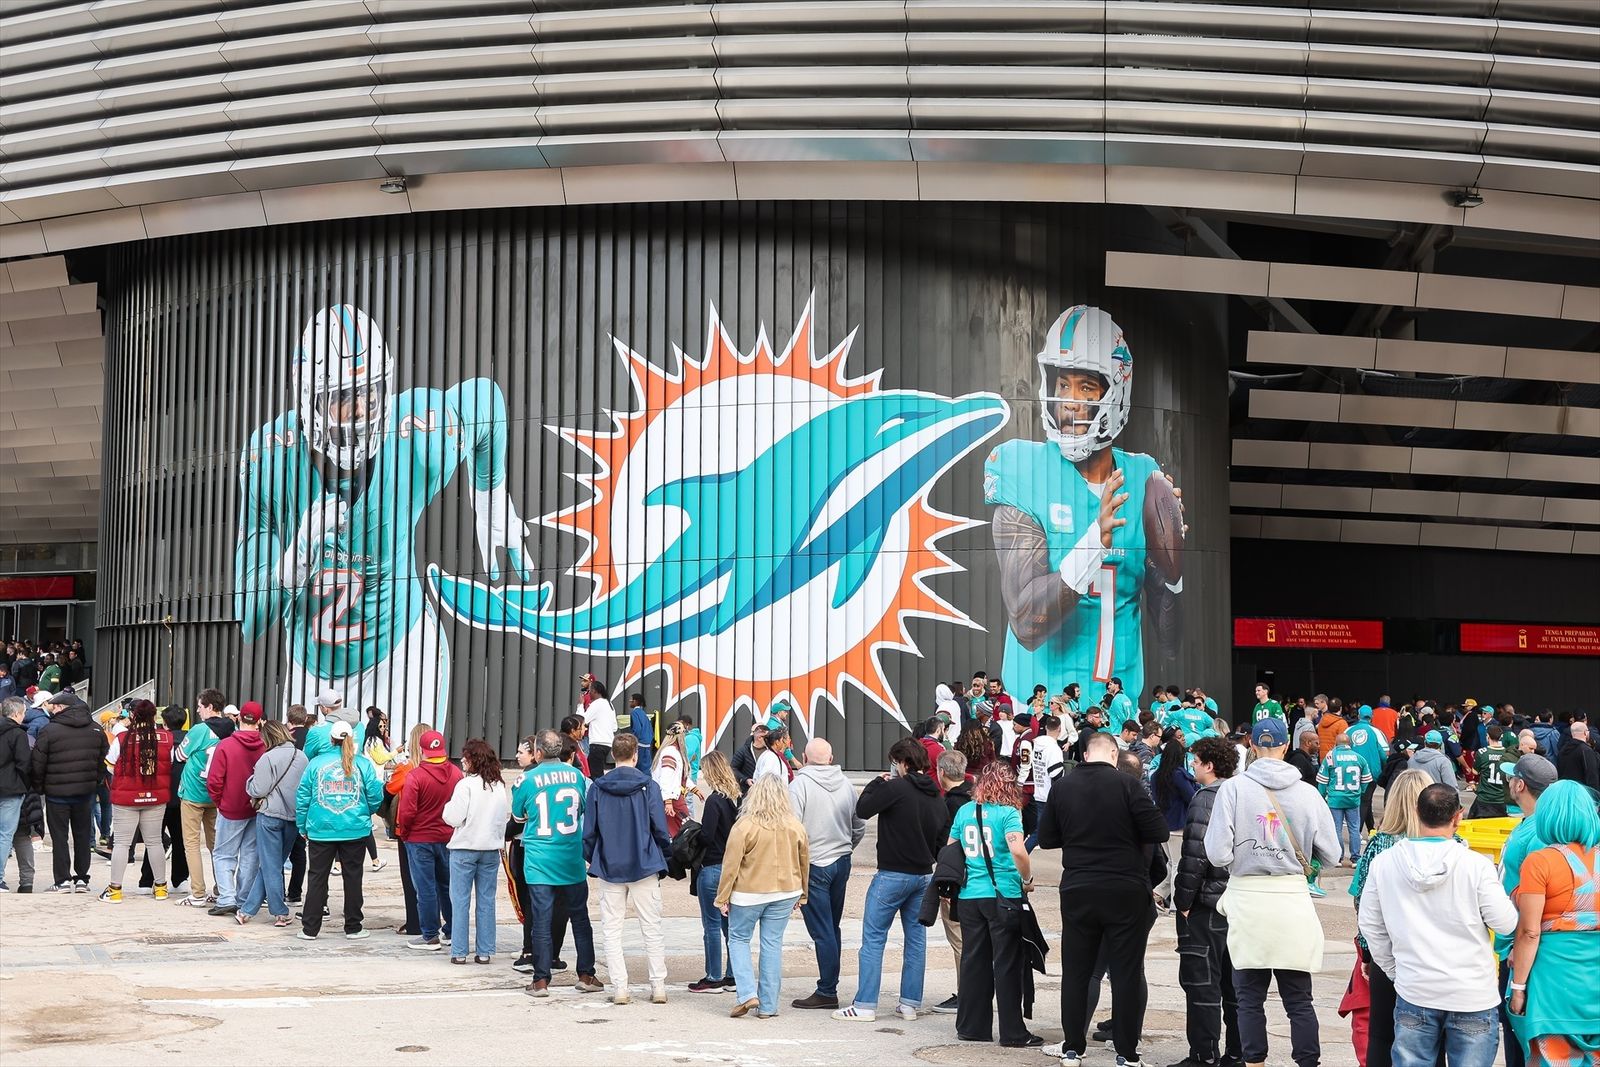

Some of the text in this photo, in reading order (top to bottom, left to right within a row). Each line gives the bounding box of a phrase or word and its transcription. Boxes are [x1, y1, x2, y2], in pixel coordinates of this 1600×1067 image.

[1050, 504, 1072, 526] C
[312, 568, 367, 645] 2
[1088, 564, 1117, 682] 1
[1315, 623, 1350, 631] PREPARADA
[533, 771, 578, 788] MARINO
[1334, 765, 1361, 791] 13
[535, 788, 579, 836] 13
